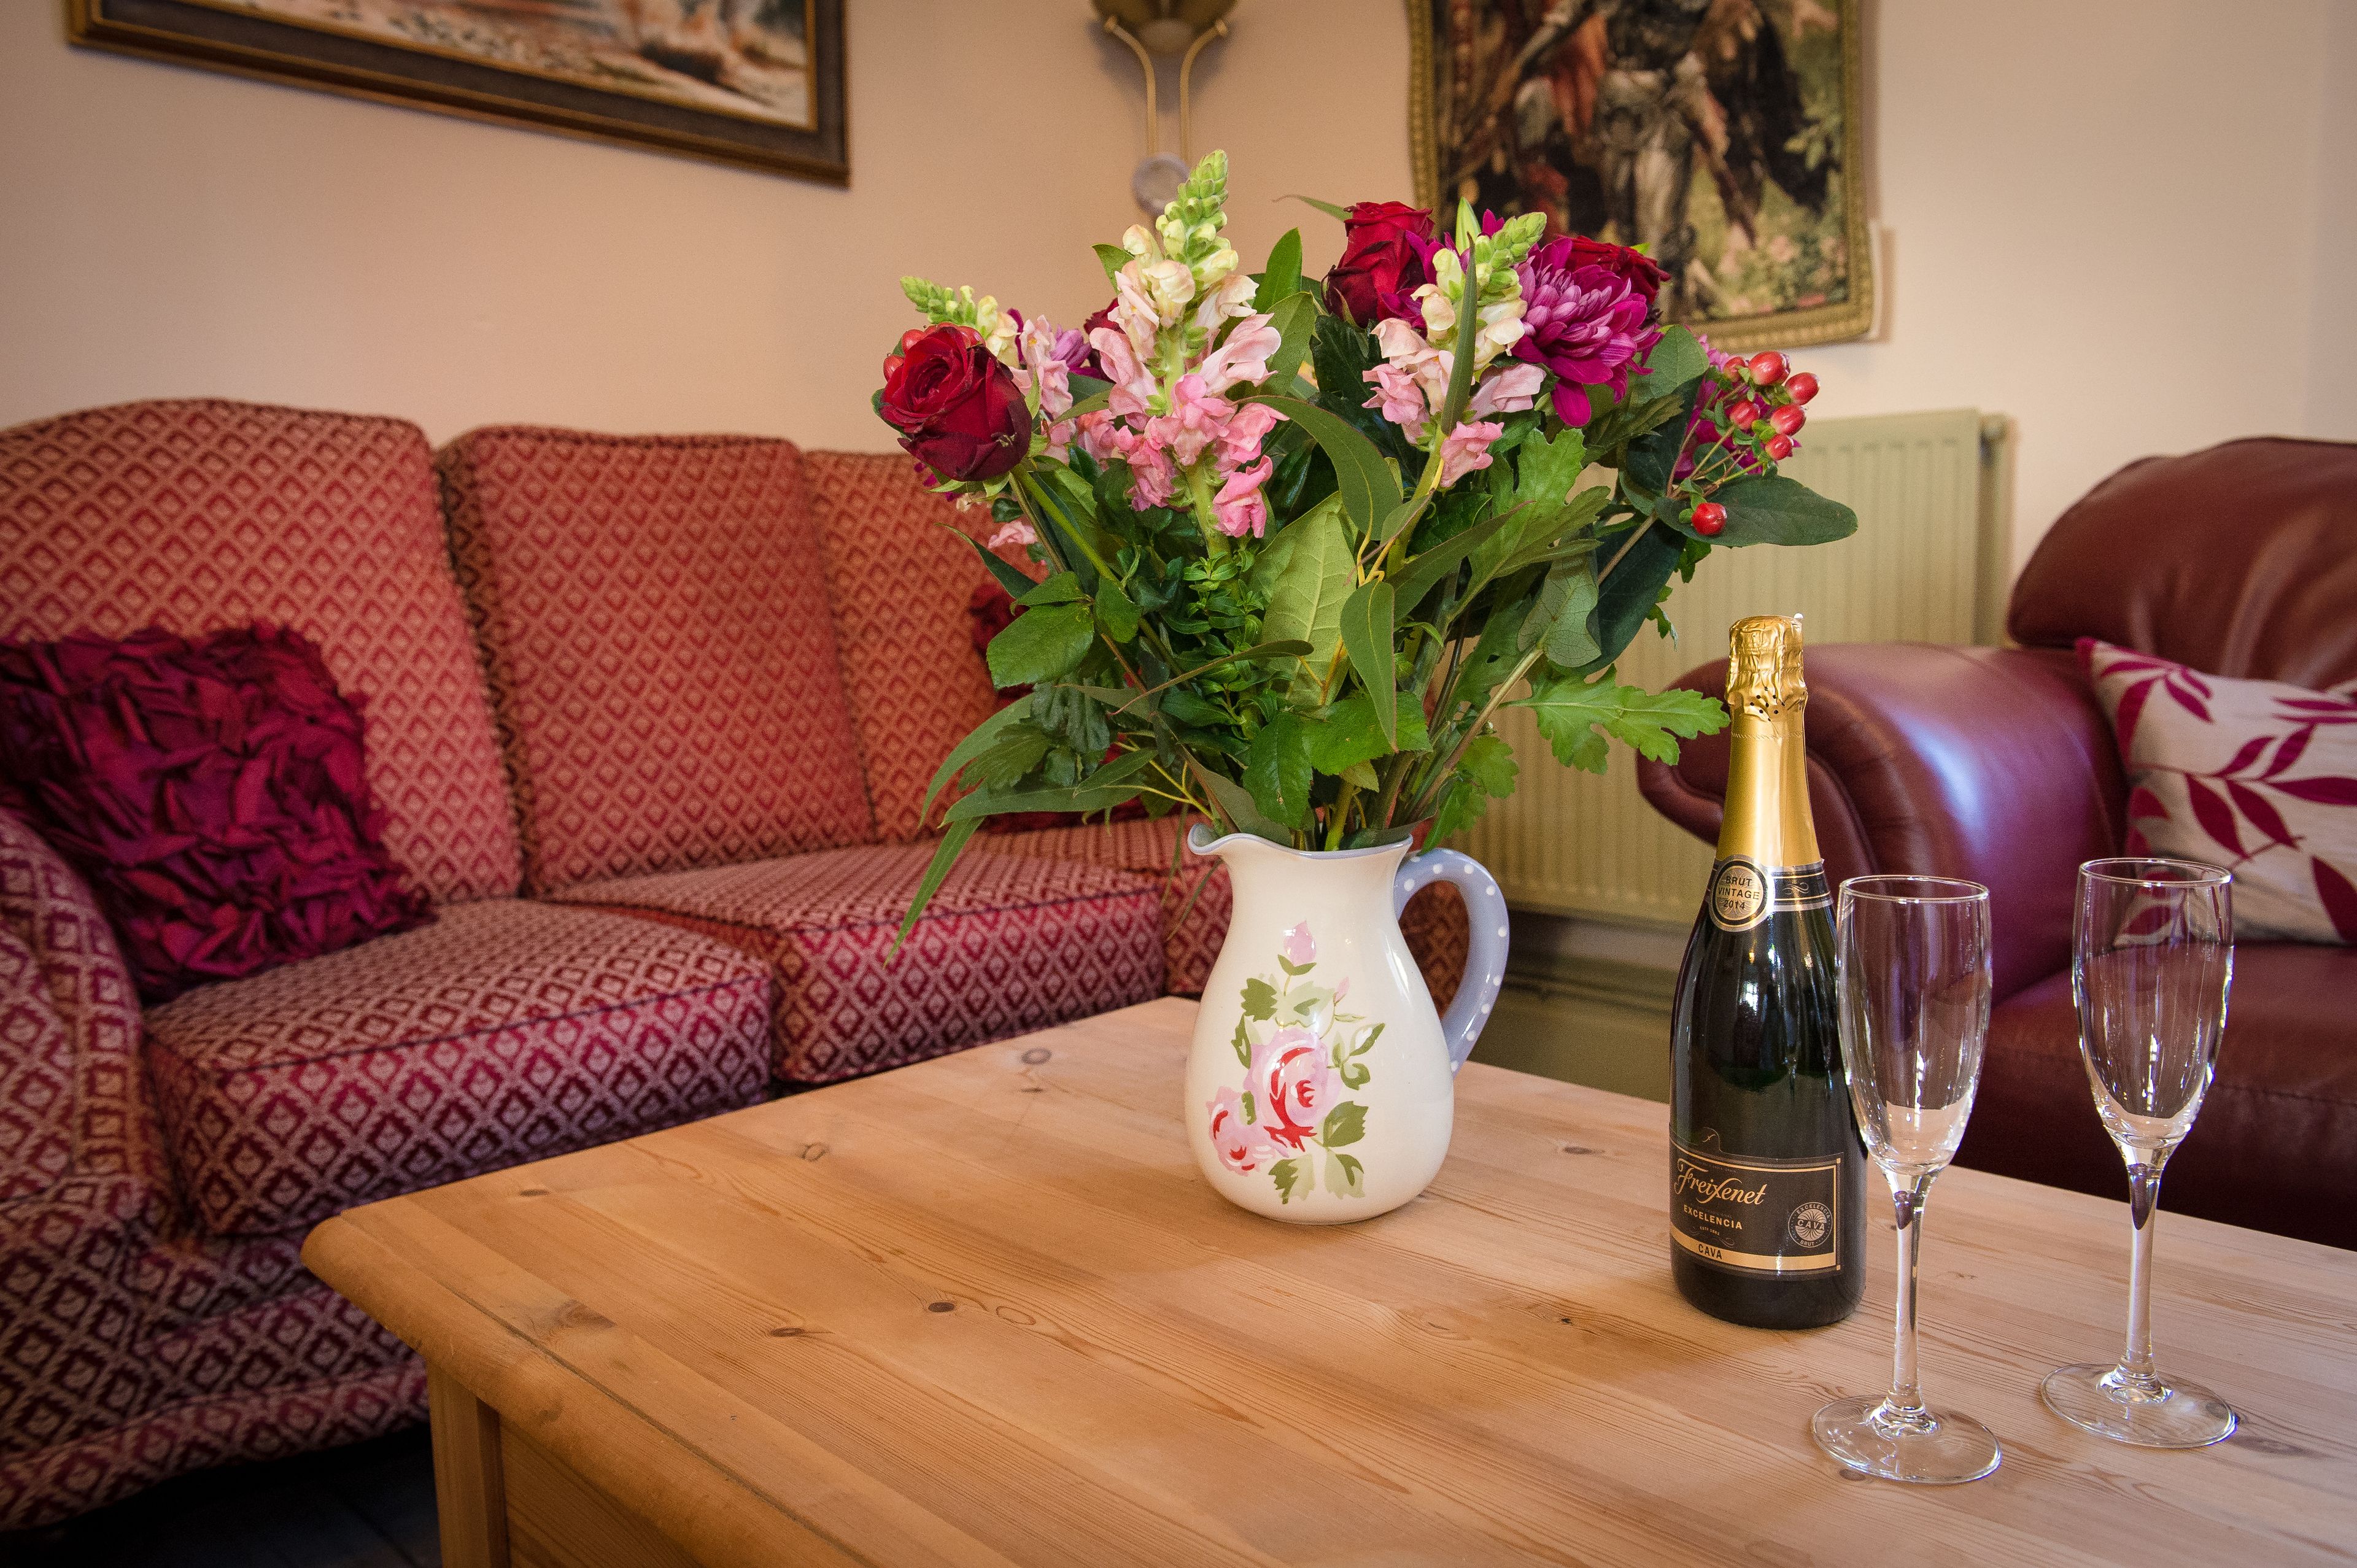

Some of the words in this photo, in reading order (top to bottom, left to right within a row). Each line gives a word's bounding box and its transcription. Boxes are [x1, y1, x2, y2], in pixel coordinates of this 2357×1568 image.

[1725, 876, 1752, 886] BRUT
[1718, 887, 1760, 900] VINTAGE
[1724, 900, 1746, 910] 2014
[1674, 1158, 1768, 1205] Freixenet
[1684, 1204, 1743, 1230] EXCELENCIA
[1796, 1203, 1830, 1219] EXCELENCIA
[1797, 1219, 1825, 1230] CAVA
[1698, 1243, 1722, 1259] CAVA
